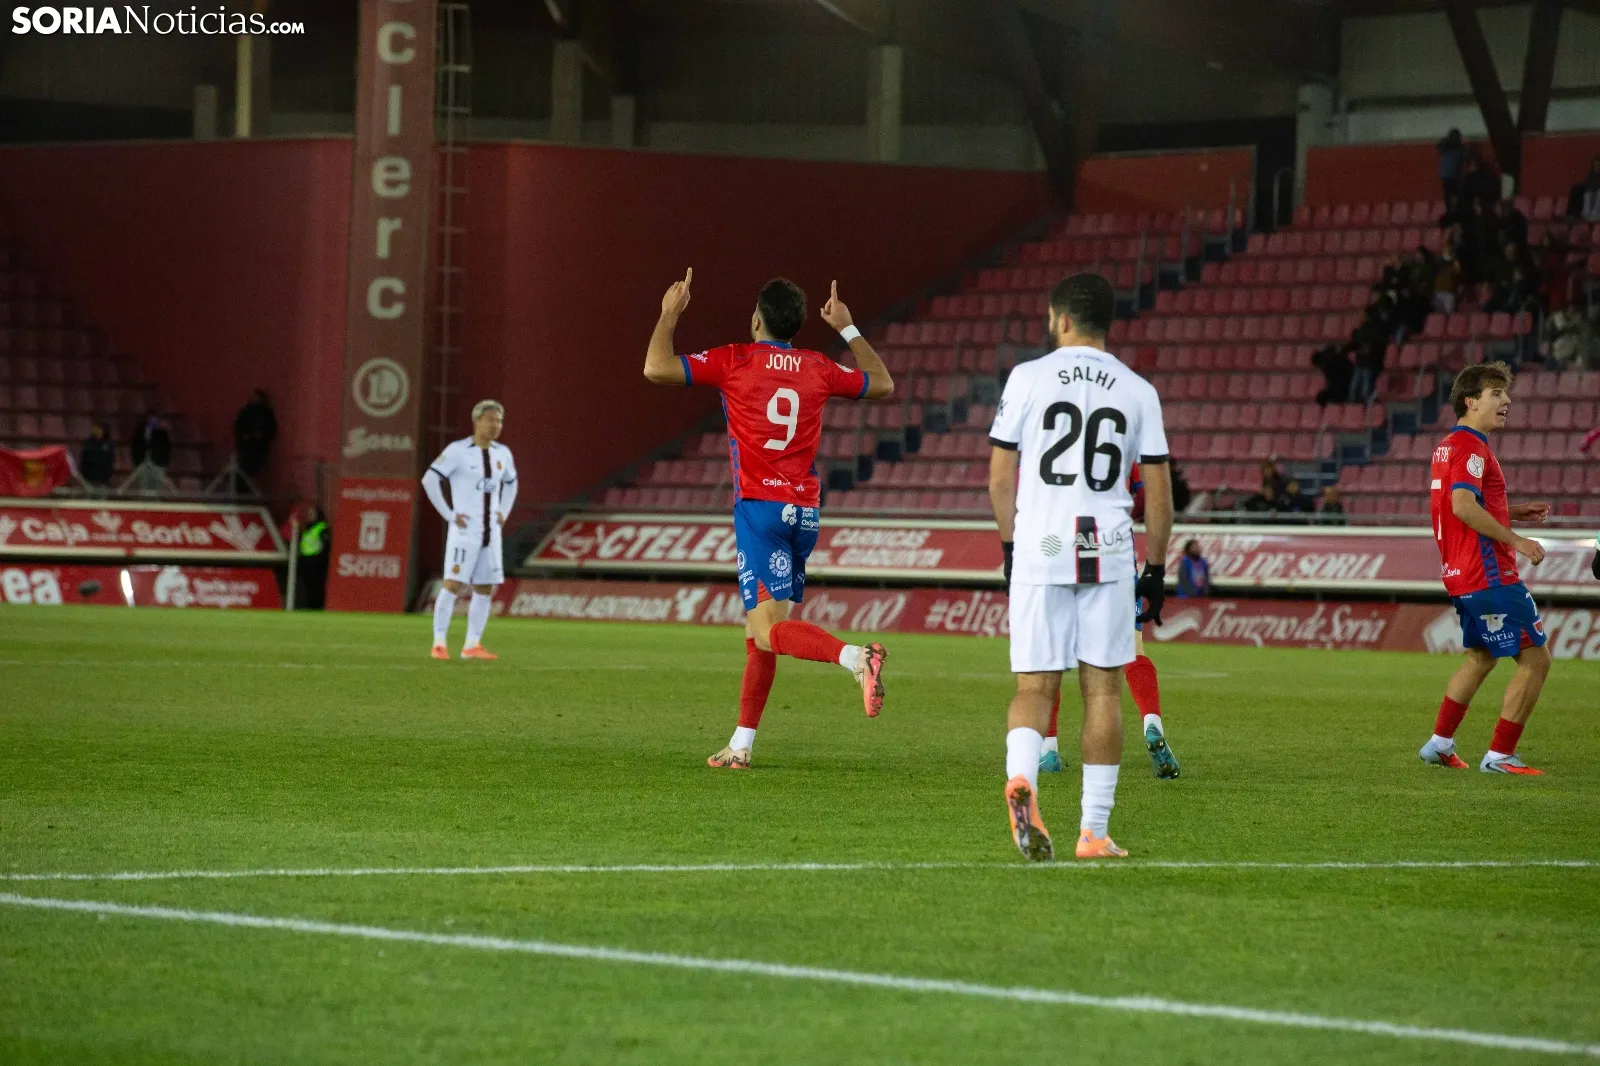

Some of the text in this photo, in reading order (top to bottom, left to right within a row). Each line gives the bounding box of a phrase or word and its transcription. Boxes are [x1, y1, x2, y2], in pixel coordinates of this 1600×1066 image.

[366, 20, 417, 320] clerc
[765, 353, 801, 372] JONY
[1058, 366, 1116, 390] SALHI
[763, 387, 800, 451] 9
[1039, 401, 1127, 492] 26
[762, 478, 782, 487] Caja
[20, 517, 213, 547] Caja Soria
[1072, 531, 1124, 549] ALUA
[337, 554, 400, 579] Soria
[1481, 630, 1515, 643] Soria
